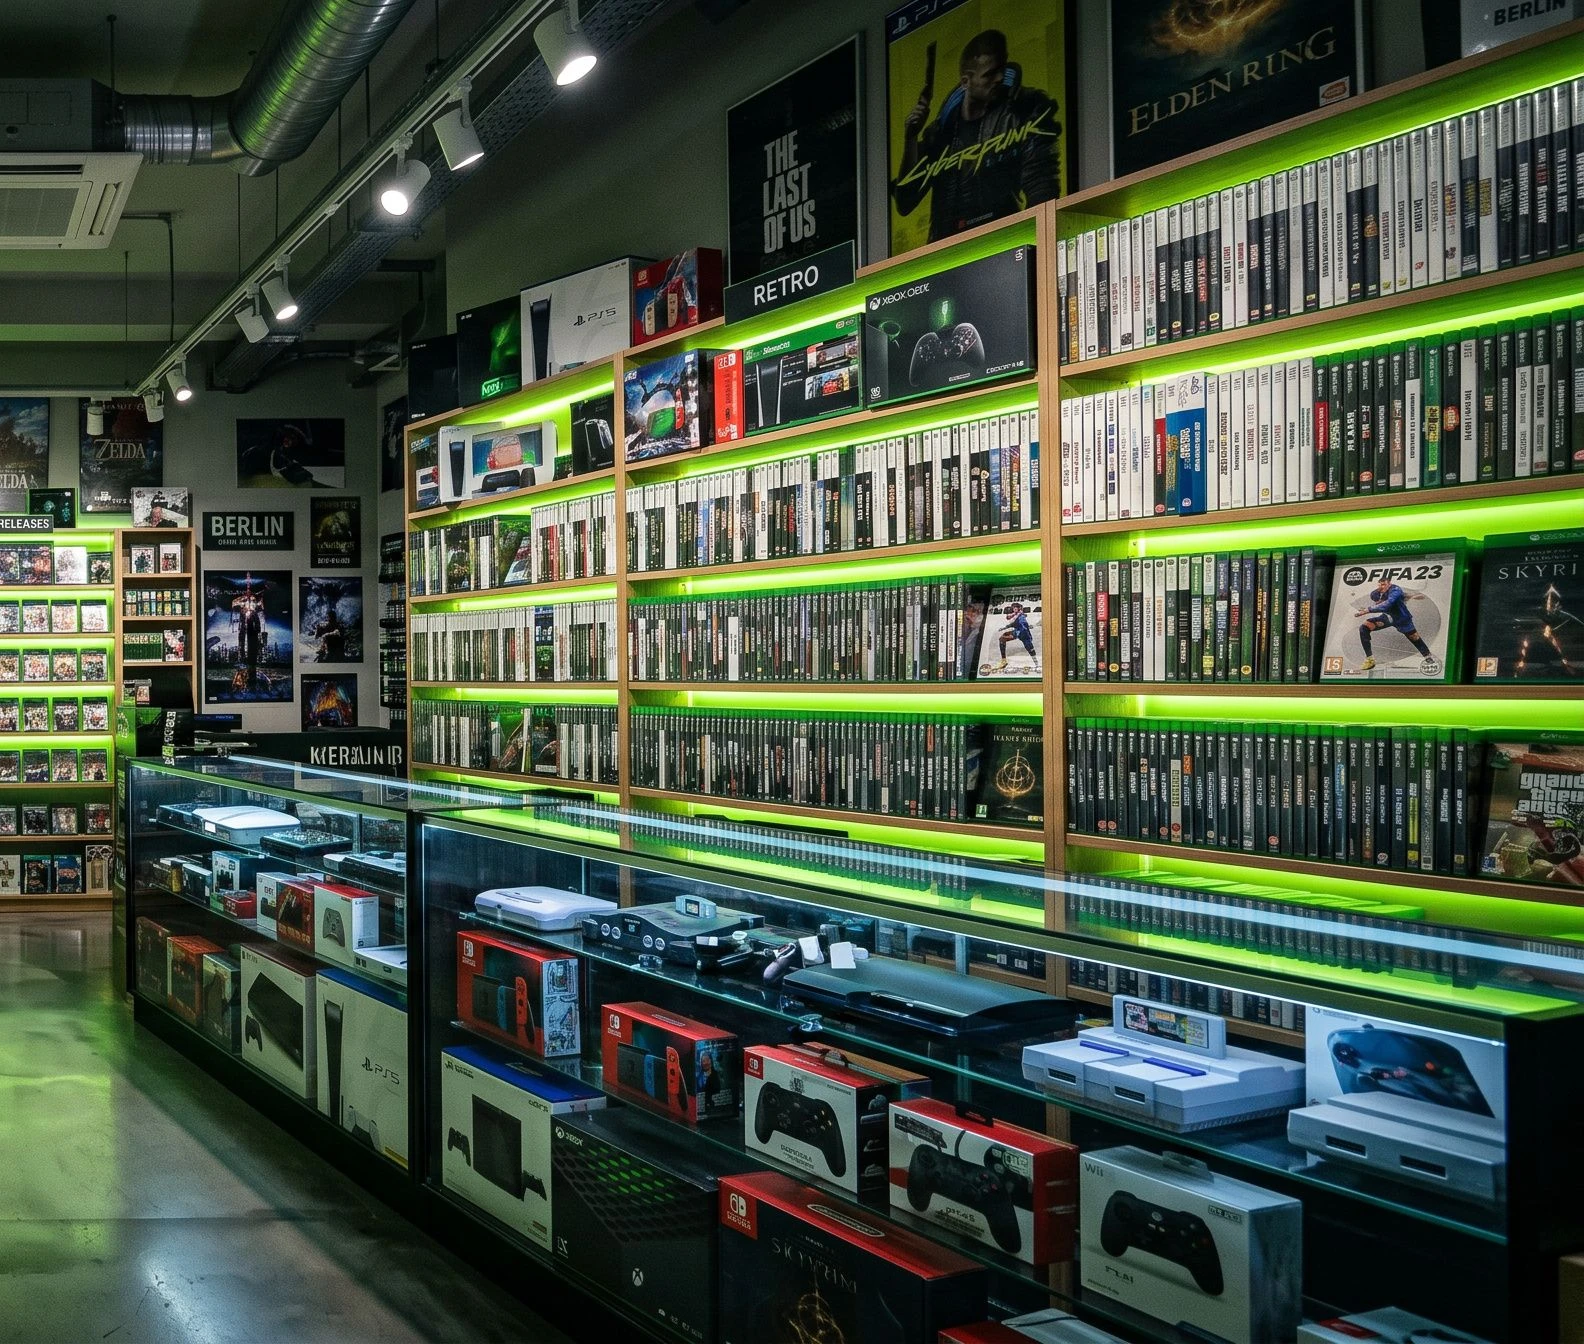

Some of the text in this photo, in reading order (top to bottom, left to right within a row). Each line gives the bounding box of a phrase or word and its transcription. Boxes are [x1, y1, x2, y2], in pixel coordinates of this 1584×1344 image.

[1494, 0, 1566, 26] BERLIN
[1127, 26, 1337, 137] ELDEN RING
[764, 130, 798, 178] THE
[763, 162, 812, 217] LAST
[764, 199, 816, 254] OF US
[753, 265, 819, 306] RETRO
[587, 307, 616, 321] PS5
[94, 438, 146, 461] ZELDA
[211, 516, 284, 537] BERLIN
[1367, 567, 1412, 583] FIFA
[1414, 565, 1443, 580] 23
[374, 1063, 400, 1085] PS5
[1084, 1162, 1104, 1177] Wii
